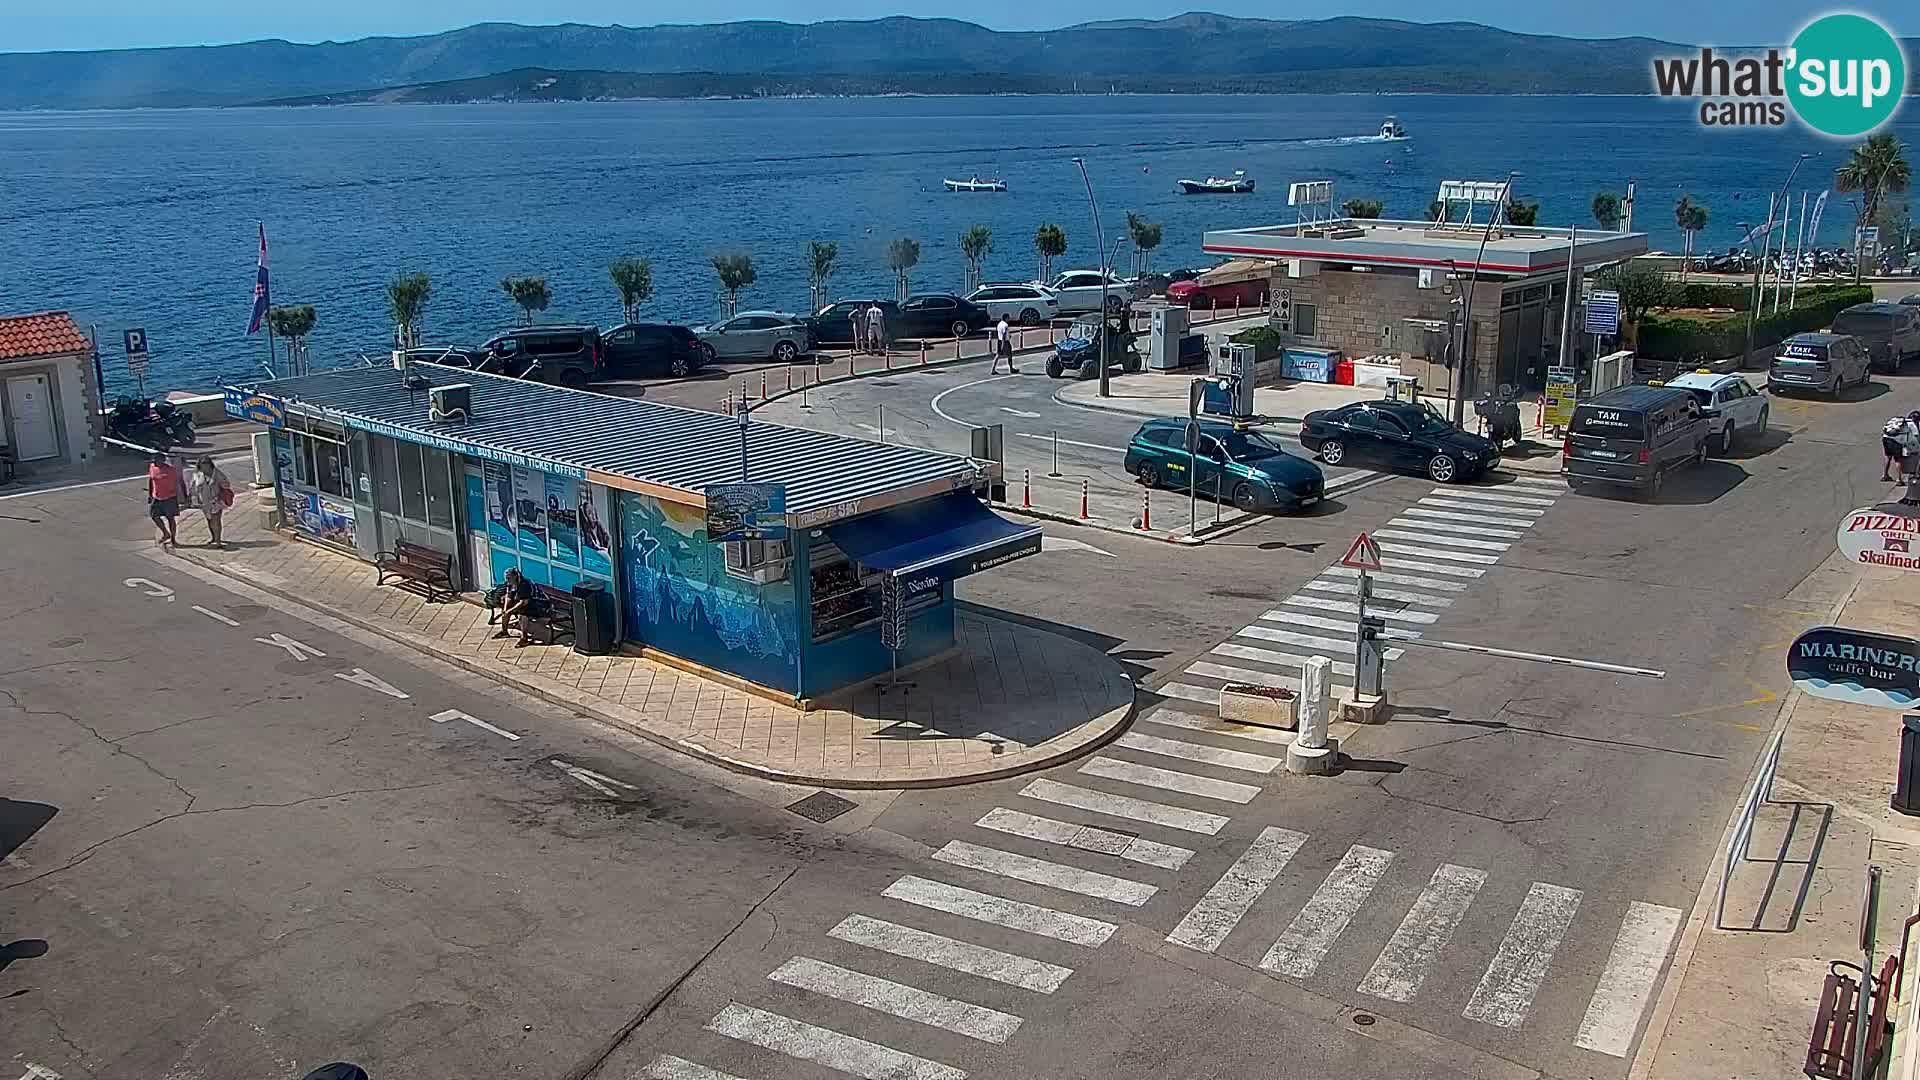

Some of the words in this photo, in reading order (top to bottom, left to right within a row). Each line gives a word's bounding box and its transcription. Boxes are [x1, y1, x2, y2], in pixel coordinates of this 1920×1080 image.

[129, 332, 141, 350] P
[1597, 410, 1620, 420] TAXI
[436, 438, 467, 453] POSTAJA
[477, 448, 492, 458] BUS
[493, 451, 525, 466] STATION
[528, 458, 553, 472] TICKET
[554, 464, 581, 478] OFFICE
[1881, 531, 1917, 541] GRILL
[908, 576, 939, 593] Novine
[1828, 662, 1865, 676] caffe
[1870, 666, 1896, 680] bar
